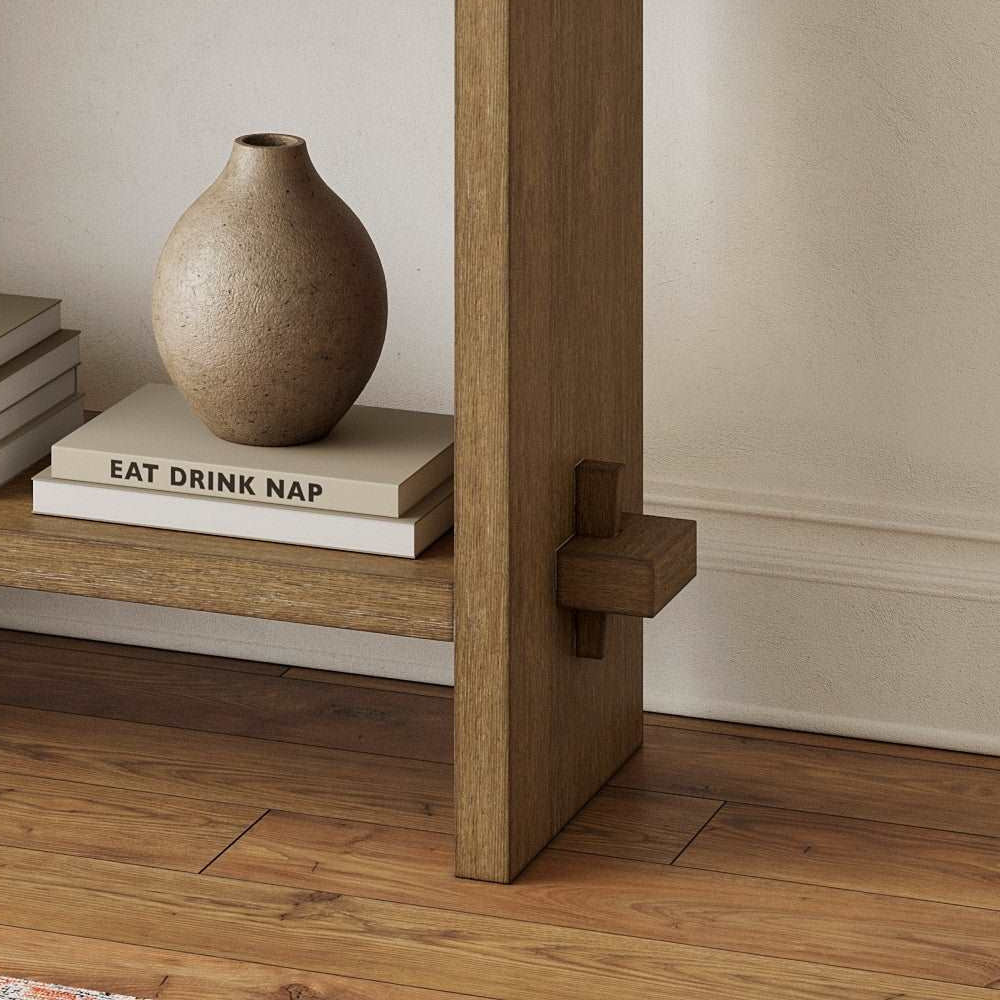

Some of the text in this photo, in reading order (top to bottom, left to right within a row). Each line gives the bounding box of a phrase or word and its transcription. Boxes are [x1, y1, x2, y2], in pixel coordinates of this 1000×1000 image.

[110, 459, 323, 503] EAT DRINK NAP
